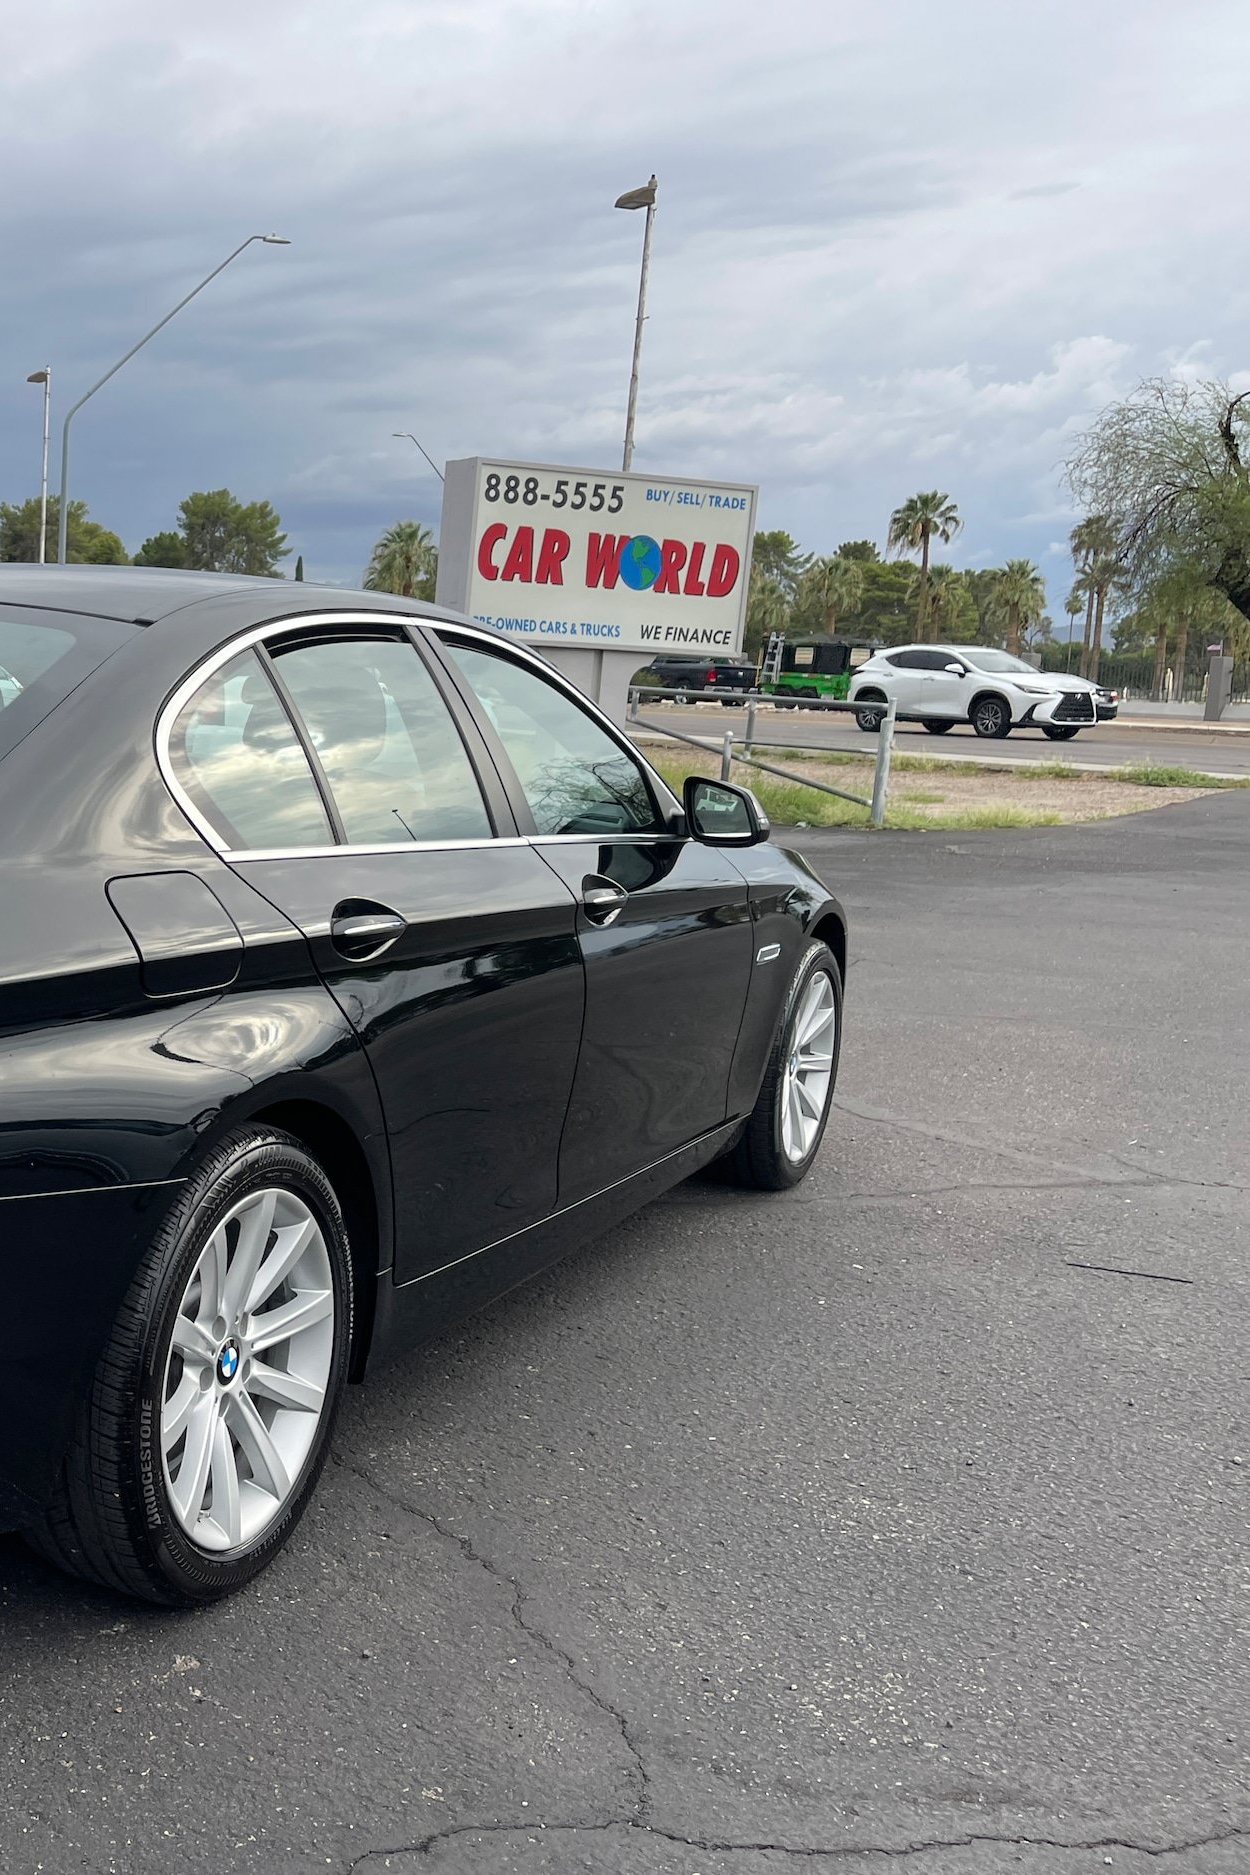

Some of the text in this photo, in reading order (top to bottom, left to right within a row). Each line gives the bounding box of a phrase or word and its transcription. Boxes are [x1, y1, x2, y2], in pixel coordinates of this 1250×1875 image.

[485, 473, 625, 513] 888-5555
[478, 522, 571, 586] CAR
[539, 620, 567, 635] CARS
[570, 622, 578, 636] &
[580, 623, 621, 638] TRUCKS
[640, 624, 732, 645] WE FINANCE
[139, 1398, 162, 1529] BRIDGESTONE
